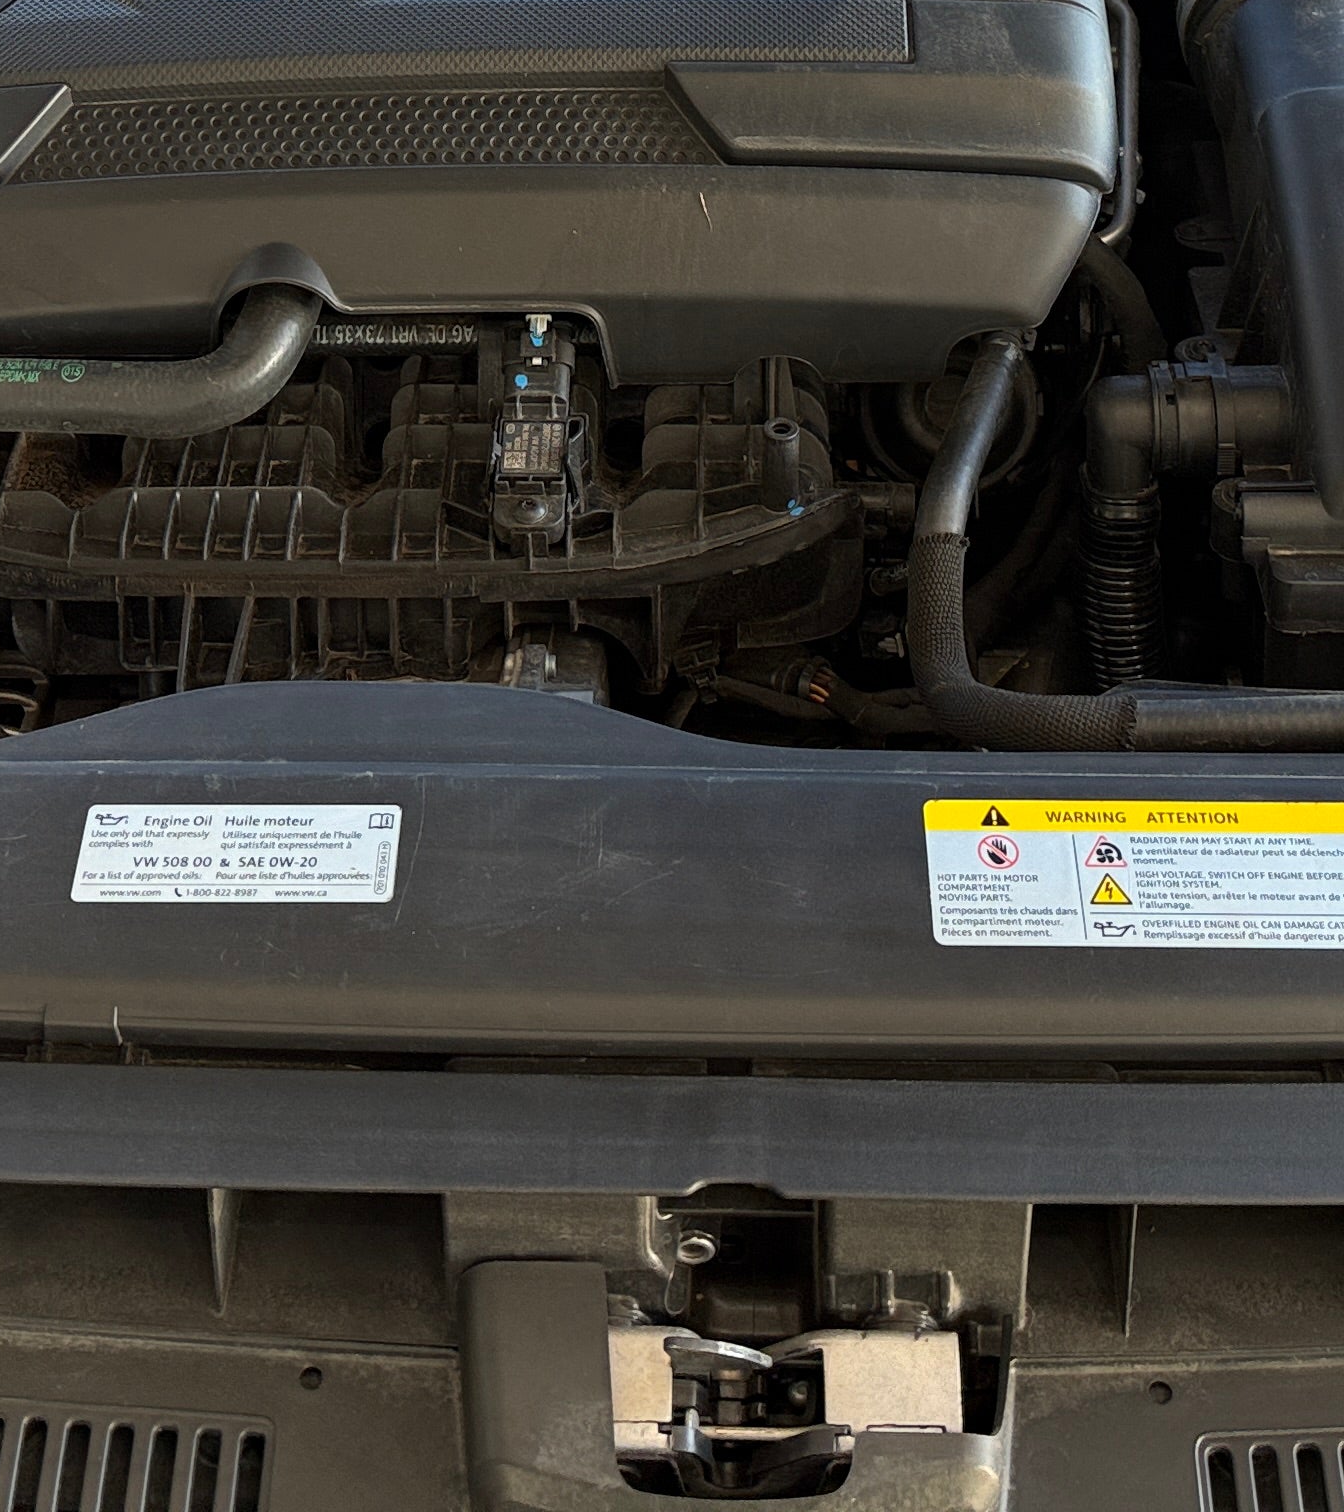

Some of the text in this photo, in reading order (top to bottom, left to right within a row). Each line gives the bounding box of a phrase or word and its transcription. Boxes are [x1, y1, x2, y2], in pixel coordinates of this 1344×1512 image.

[426, 324, 447, 344] DE
[452, 324, 475, 344] AG
[144, 815, 213, 829] Engine Oil
[225, 815, 314, 827] Huile moteur
[1045, 811, 1239, 824] WARNING ATTENTION
[91, 829, 209, 840] Use only oil that expressly
[222, 830, 257, 839] Utilisez
[259, 831, 317, 841] uniquement
[320, 831, 331, 839] de
[89, 840, 153, 849] complies with
[220, 841, 352, 850] qui satisfait expressément à
[1130, 836, 1177, 844] RADIATOR
[1223, 837, 1252, 845] START
[1255, 837, 1265, 845] AT
[1132, 847, 1143, 855] Le
[1215, 848, 1259, 856] radiateur
[1262, 848, 1284, 858] peut
[133, 857, 318, 867] VW 508 00 & SAE 0W-20
[82, 871, 97, 880] For
[107, 871, 121, 880] list
[124, 870, 135, 880] of
[136, 871, 181, 882] approved
[215, 871, 236, 880] Pour
[239, 872, 256, 880] une
[258, 871, 276, 880] liste
[279, 871, 315, 880] d'huiles
[937, 874, 1039, 882] HOT PARTS IN MOTOR
[1207, 871, 1245, 879] SWITCH
[1247, 871, 1265, 879] OFF
[1267, 872, 1304, 880] ENGINE
[1306, 872, 1344, 880] BEFORE
[1136, 879, 1180, 888] IGNITION
[100, 889, 161, 897] www.vw.com
[275, 889, 327, 897] www.vw.ca
[939, 894, 978, 902] MOVING
[1138, 891, 1168, 900] Haute
[1212, 891, 1245, 900] arrêter
[1248, 892, 1257, 900] le
[1259, 892, 1295, 900] moteur
[1298, 893, 1326, 901] avant
[1328, 893, 1341, 901] de
[940, 906, 1078, 916] Composants très chauds dans
[940, 917, 949, 925] le
[952, 917, 1022, 927] compartiment
[1142, 920, 1201, 928] OVERFILLED
[1204, 920, 1240, 928] ENGINE
[1242, 920, 1258, 928] OIL
[1261, 921, 1281, 929] CAN
[1283, 921, 1324, 929] DAMAGE
[942, 928, 972, 936] Pièces
[1143, 930, 1205, 941] Remplissage
[1208, 931, 1246, 940] excessif
[1248, 931, 1281, 940] d'huile
[1283, 932, 1335, 942] dangereux
